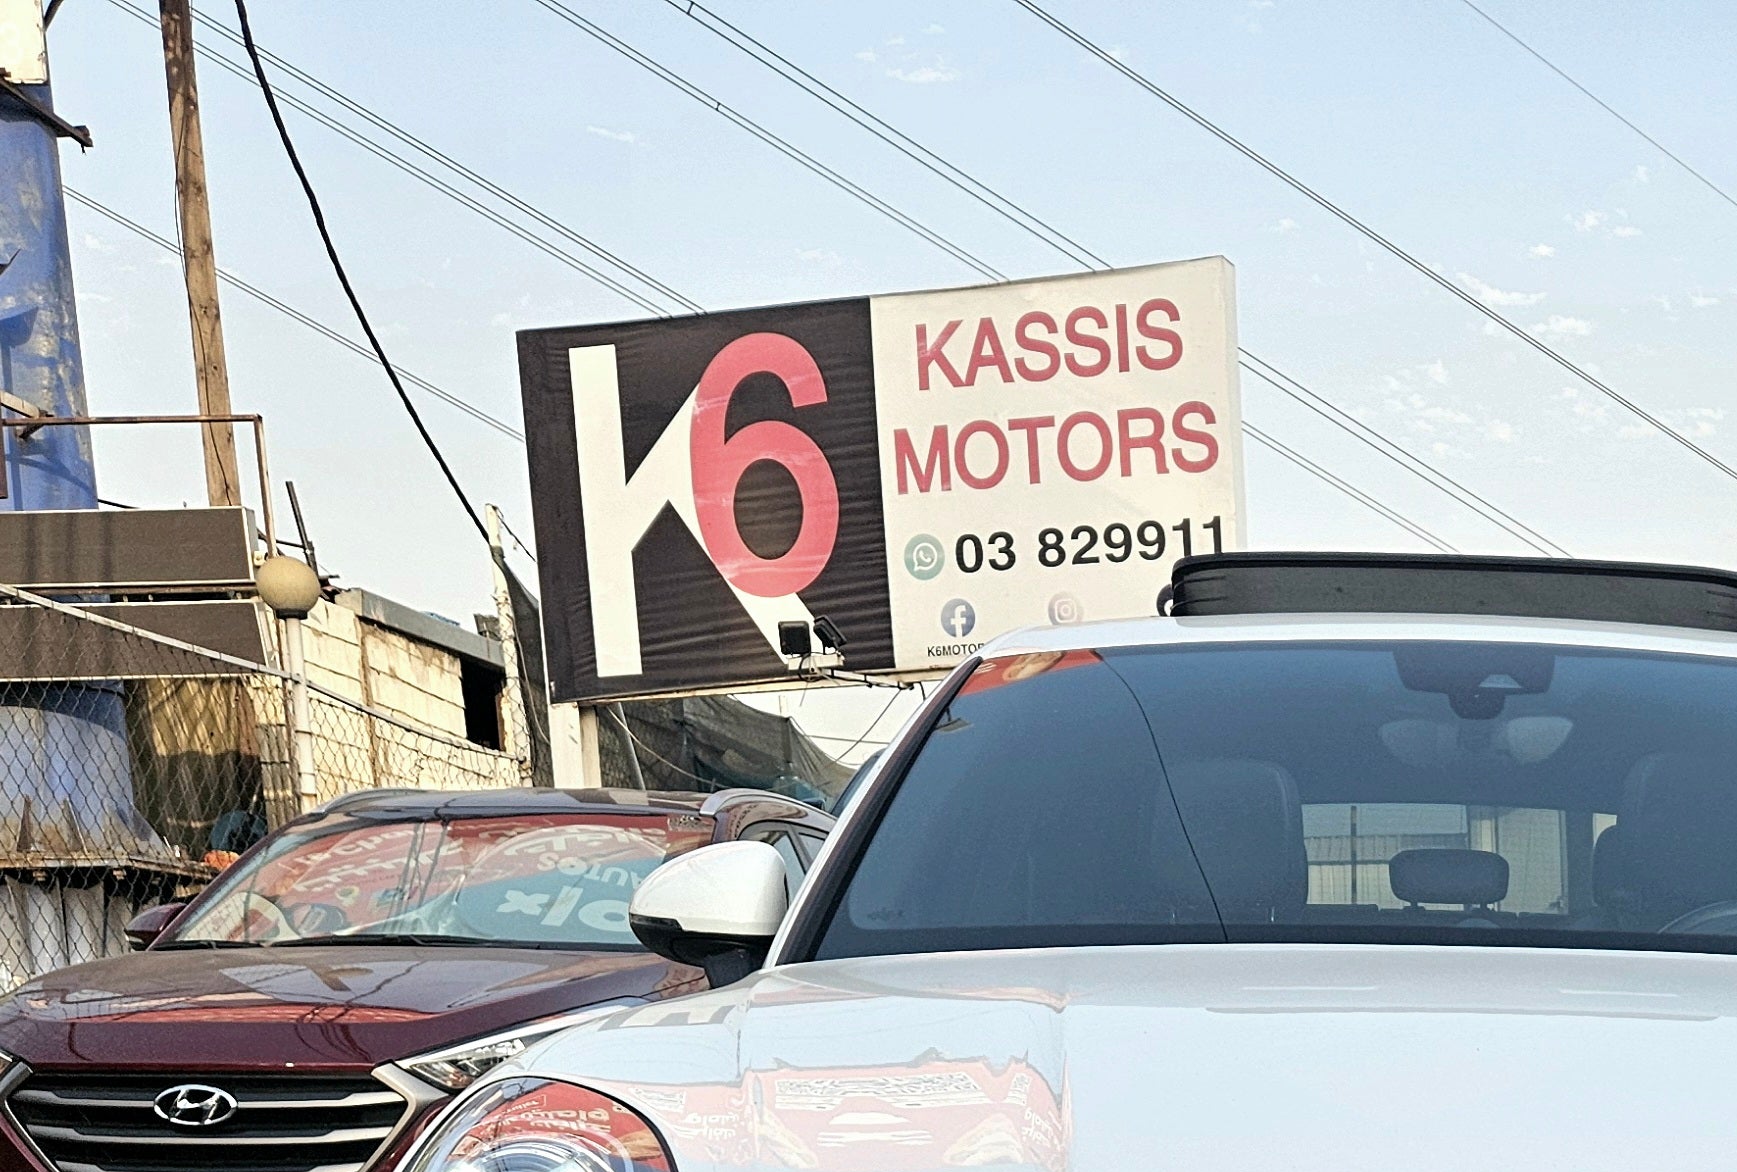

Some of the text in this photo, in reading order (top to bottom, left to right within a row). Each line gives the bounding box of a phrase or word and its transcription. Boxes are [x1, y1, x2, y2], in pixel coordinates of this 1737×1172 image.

[915, 297, 1184, 391] KASSIS
[894, 401, 1219, 495] MOTORS
[568, 332, 841, 677] K6
[955, 516, 1225, 573] 03 829911
